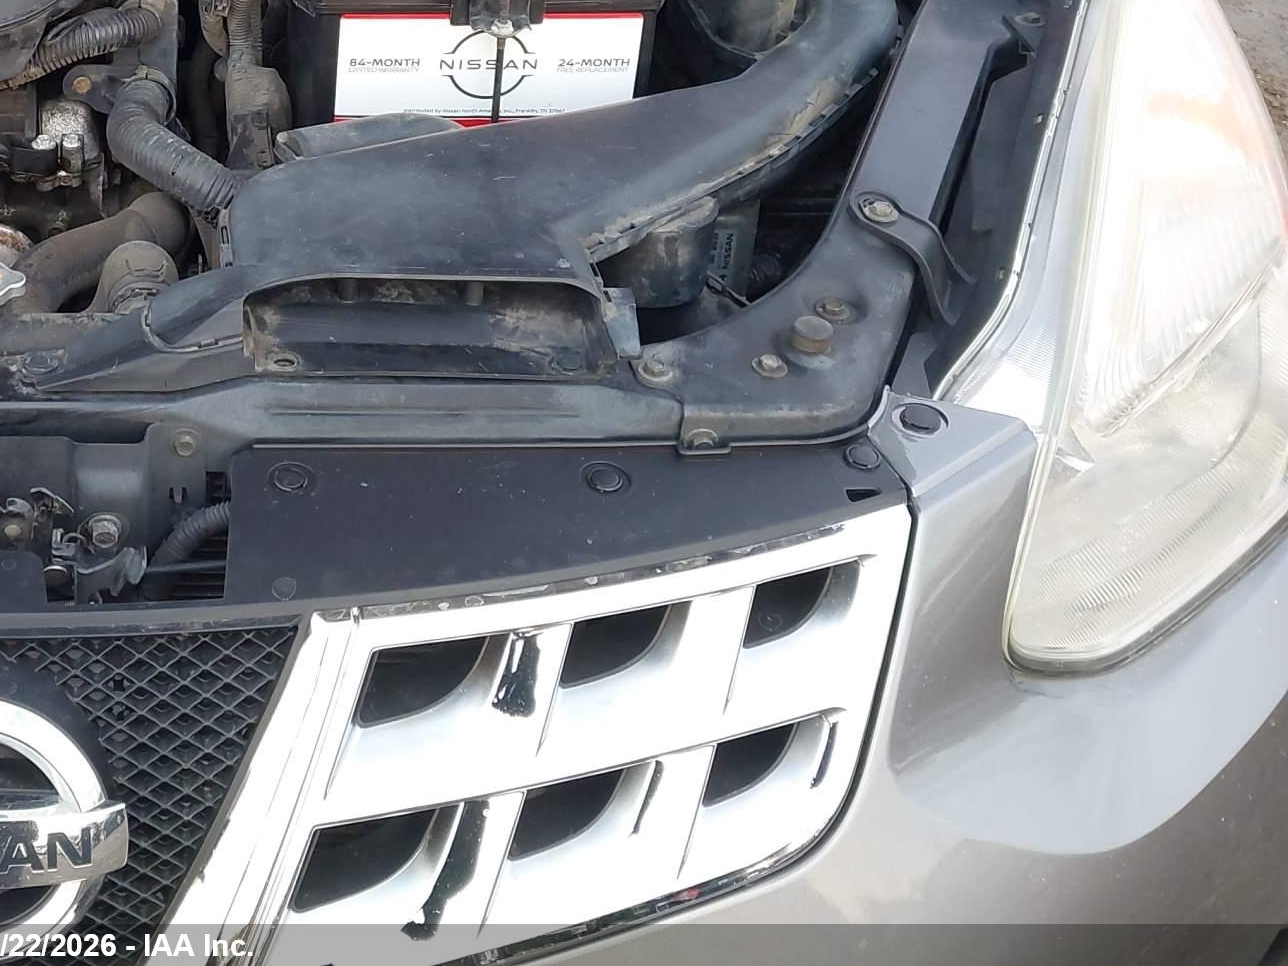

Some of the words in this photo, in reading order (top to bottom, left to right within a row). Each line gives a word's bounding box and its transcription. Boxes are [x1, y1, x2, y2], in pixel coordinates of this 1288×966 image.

[349, 58, 420, 67] 84-MONTH
[439, 59, 538, 70] NISSAN
[557, 58, 631, 67] 24-MONTH
